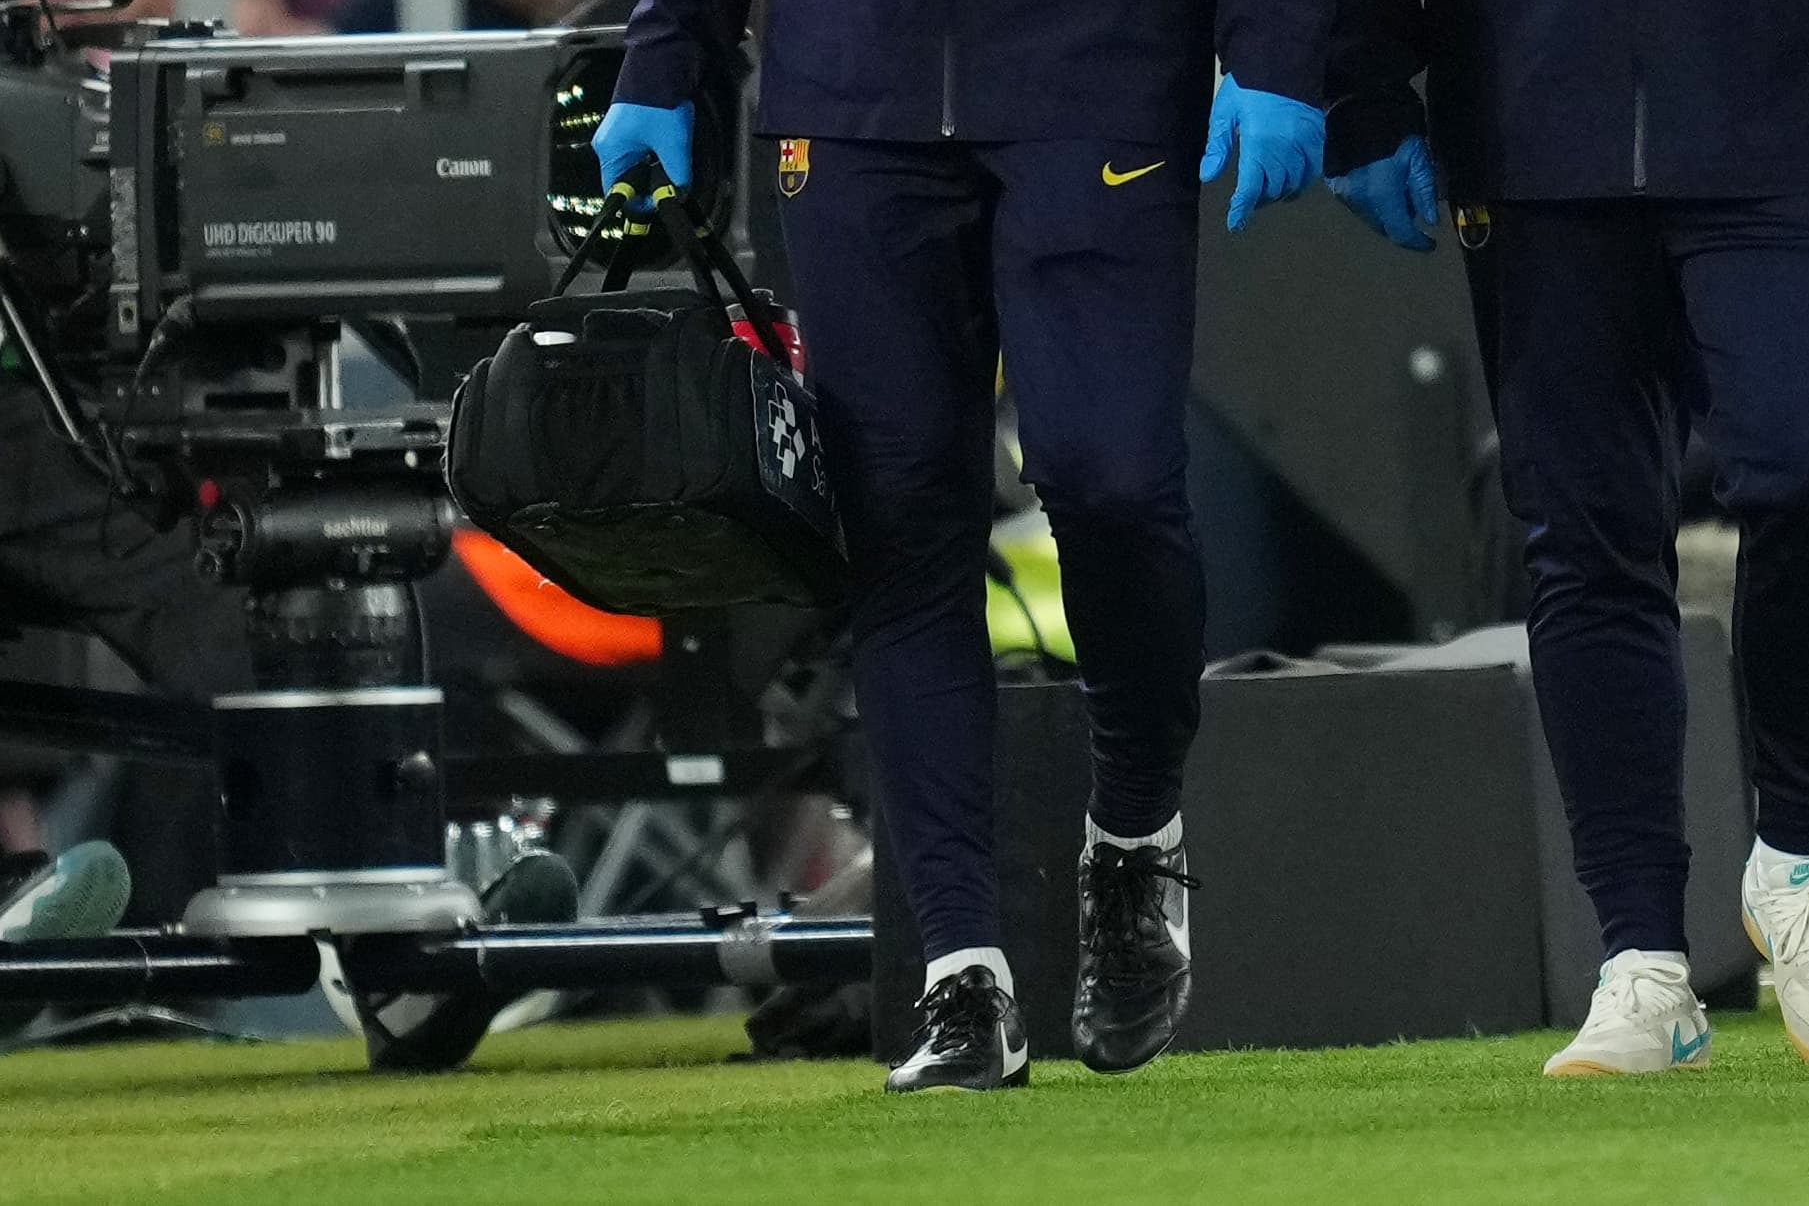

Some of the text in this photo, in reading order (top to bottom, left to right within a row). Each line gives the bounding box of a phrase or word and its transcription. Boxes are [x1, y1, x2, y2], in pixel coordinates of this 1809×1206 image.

[436, 158, 492, 176] Canon
[203, 220, 337, 247] UHD DIGISUPER 90
